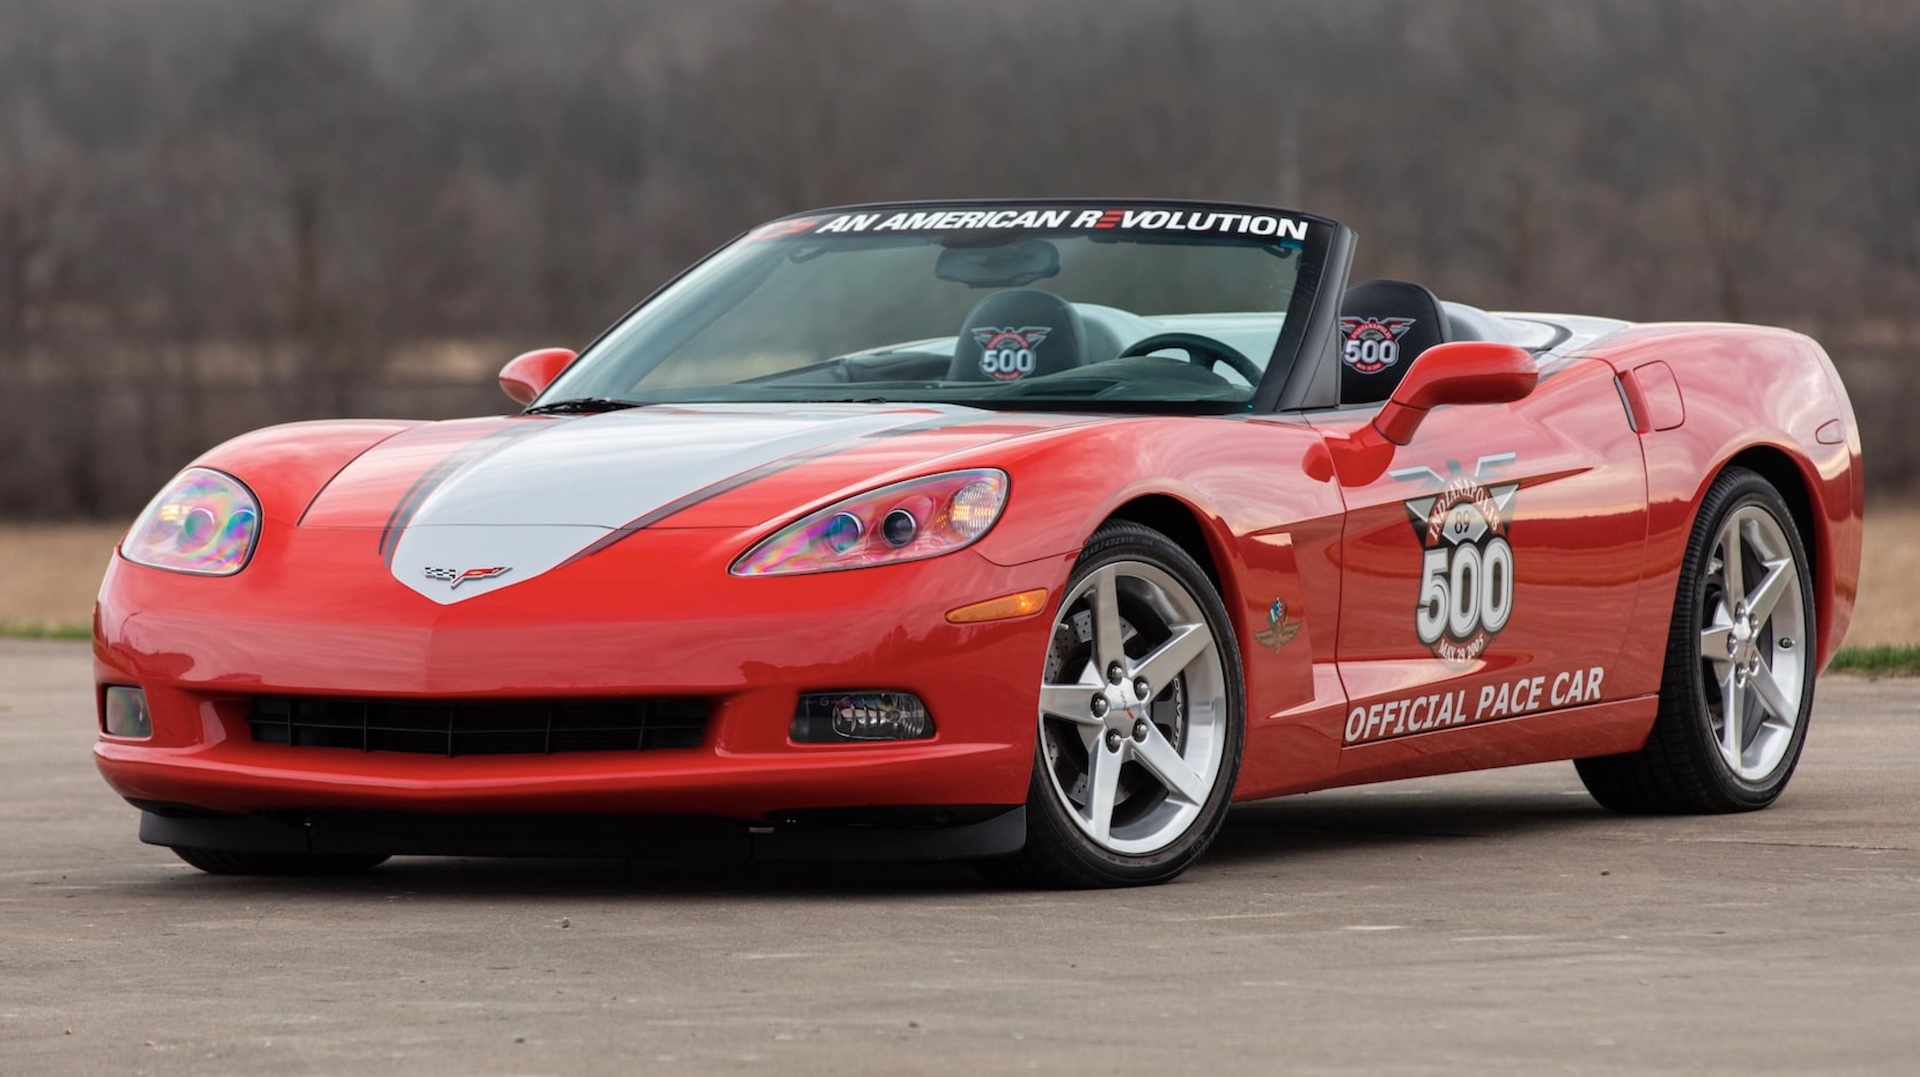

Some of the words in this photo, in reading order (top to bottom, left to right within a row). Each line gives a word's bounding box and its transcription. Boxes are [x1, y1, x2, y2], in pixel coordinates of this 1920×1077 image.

[815, 213, 881, 233] AN
[873, 210, 1071, 231] AMERICAN
[1070, 209, 1309, 241] REVOLUTION
[982, 348, 1034, 373] 500
[1344, 339, 1398, 364] 500
[1429, 479, 1500, 541] INDIANAPOLIS
[1416, 537, 1514, 644] 500
[1439, 638, 1456, 662] MAY
[1456, 647, 1466, 664] 29
[1466, 633, 1484, 660] 2005
[1345, 690, 1467, 742] OFFICIAL
[1475, 676, 1546, 720] PACE
[1550, 667, 1605, 707] CAR
